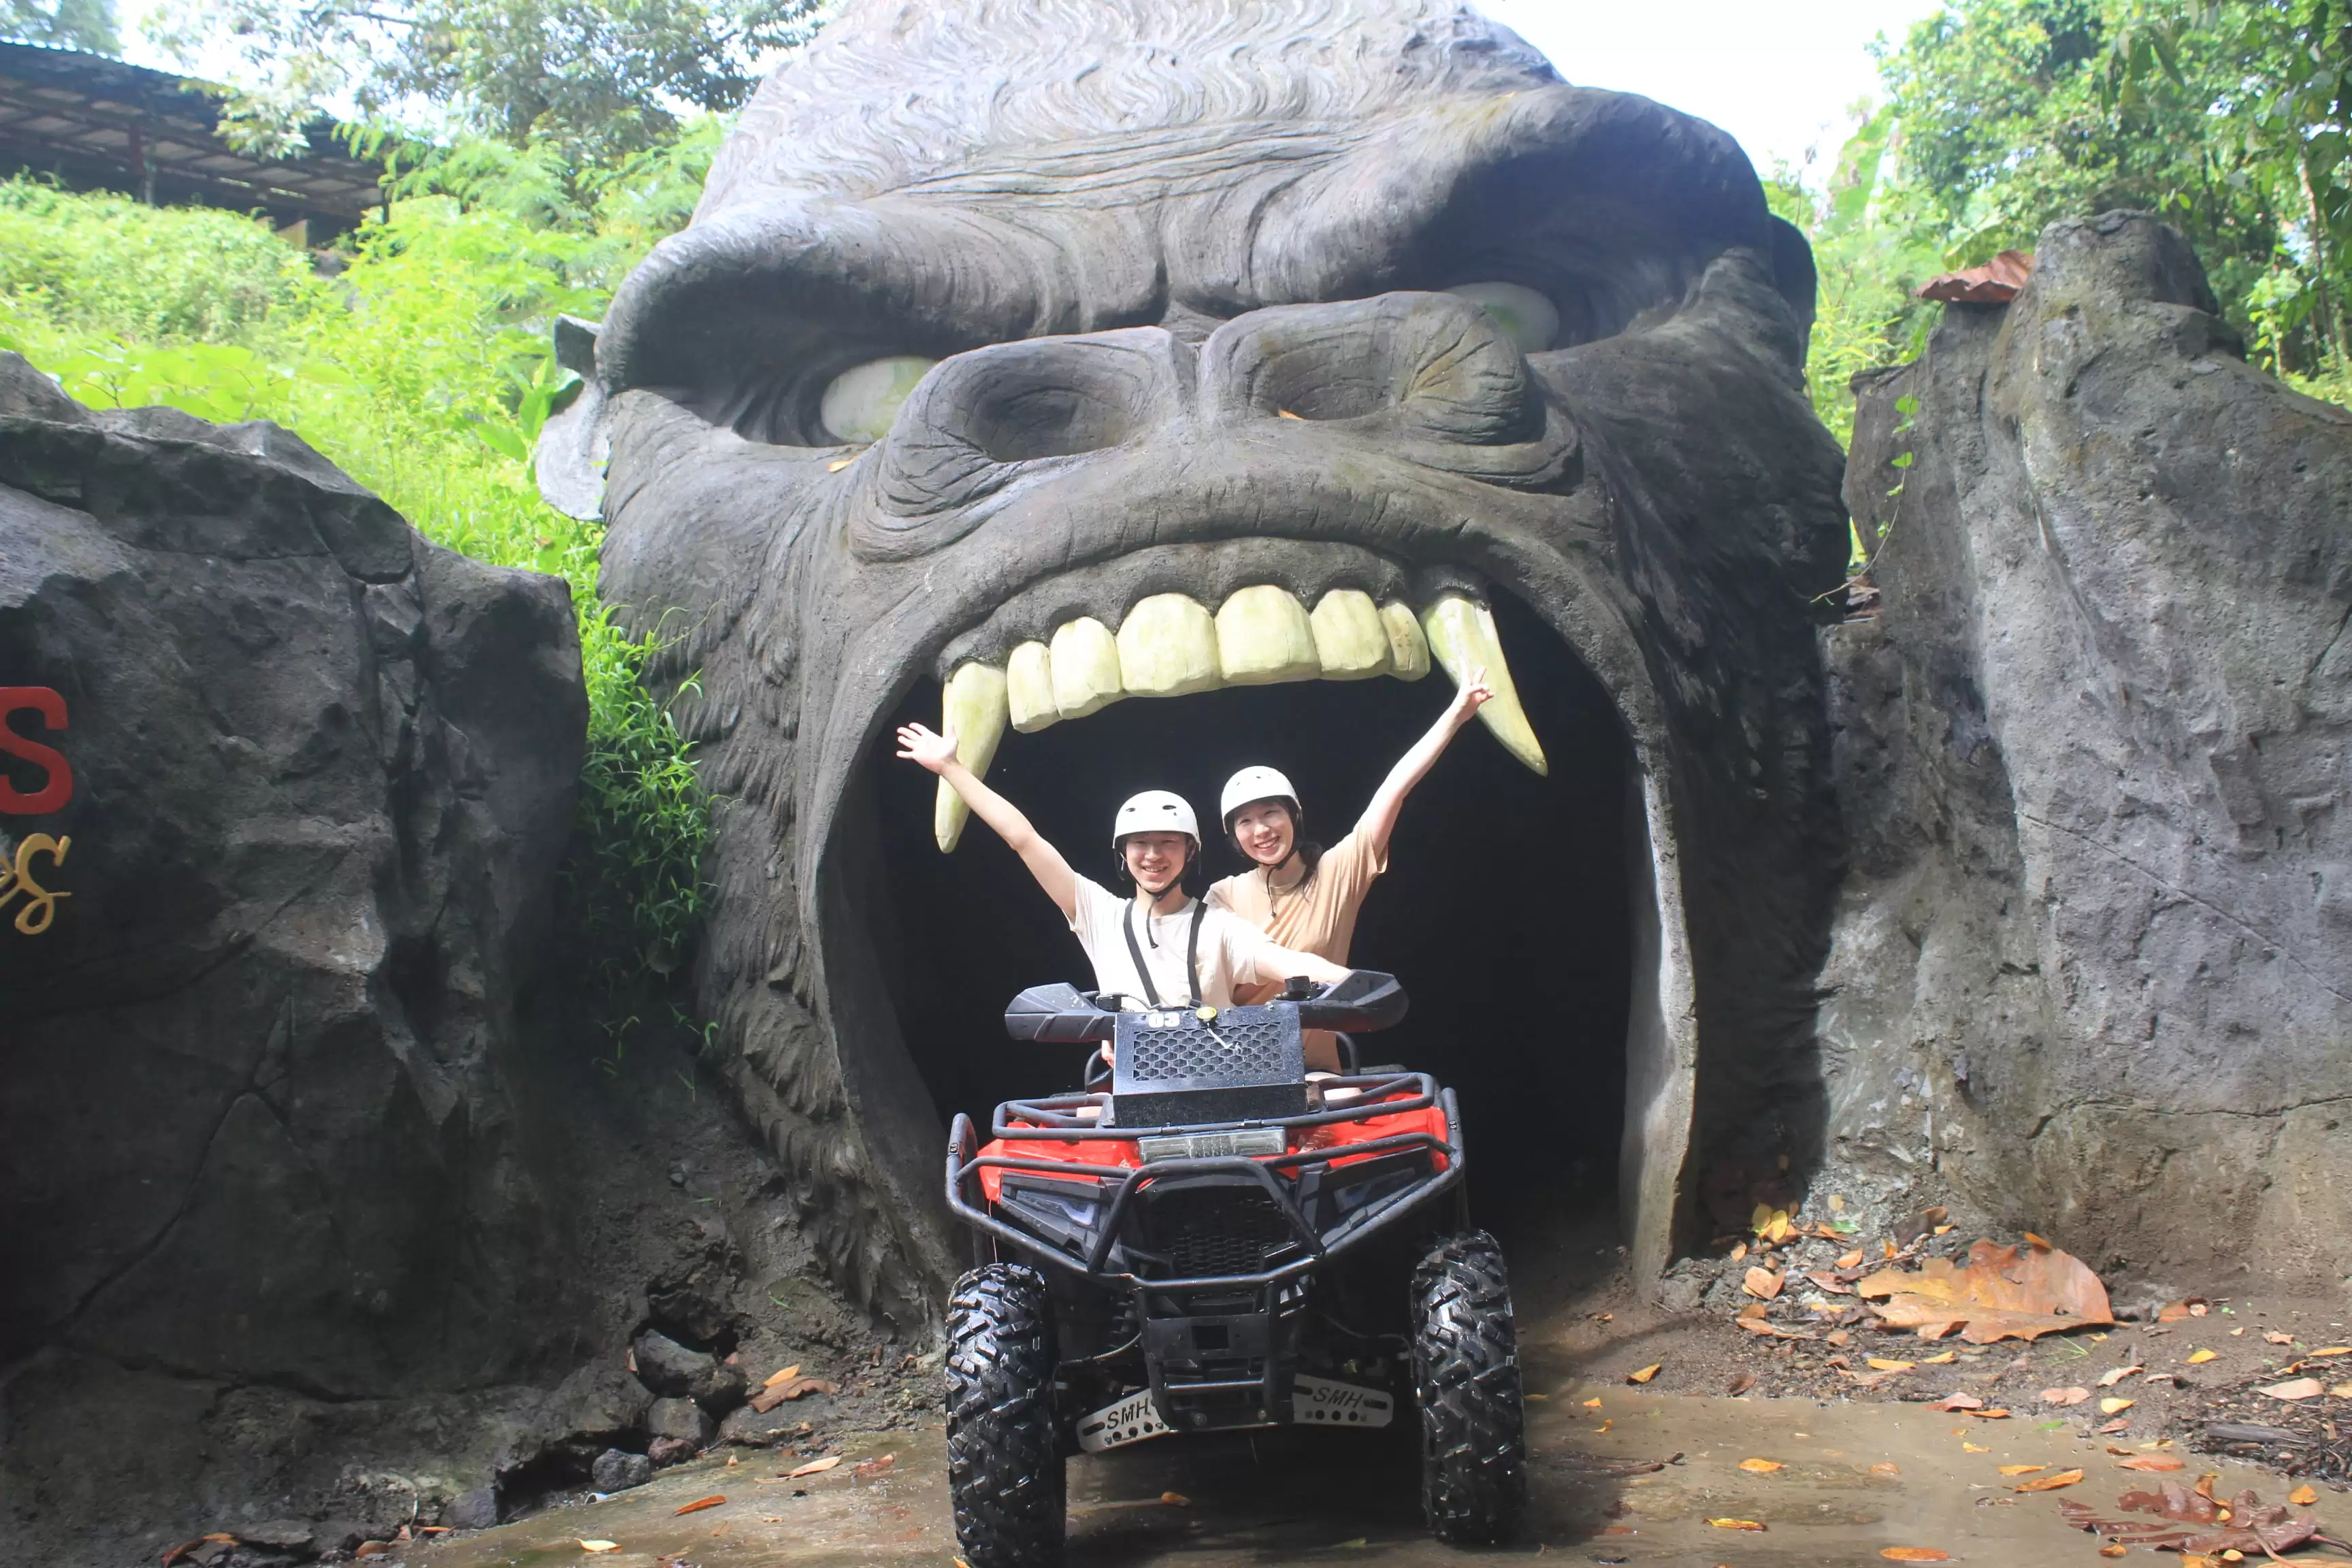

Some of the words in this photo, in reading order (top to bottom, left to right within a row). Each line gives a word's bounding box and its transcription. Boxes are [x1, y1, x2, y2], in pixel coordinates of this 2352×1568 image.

[1148, 1012, 1180, 1028] 03
[1313, 1386, 1365, 1408] SMH
[1107, 1397, 1151, 1429] SMH
